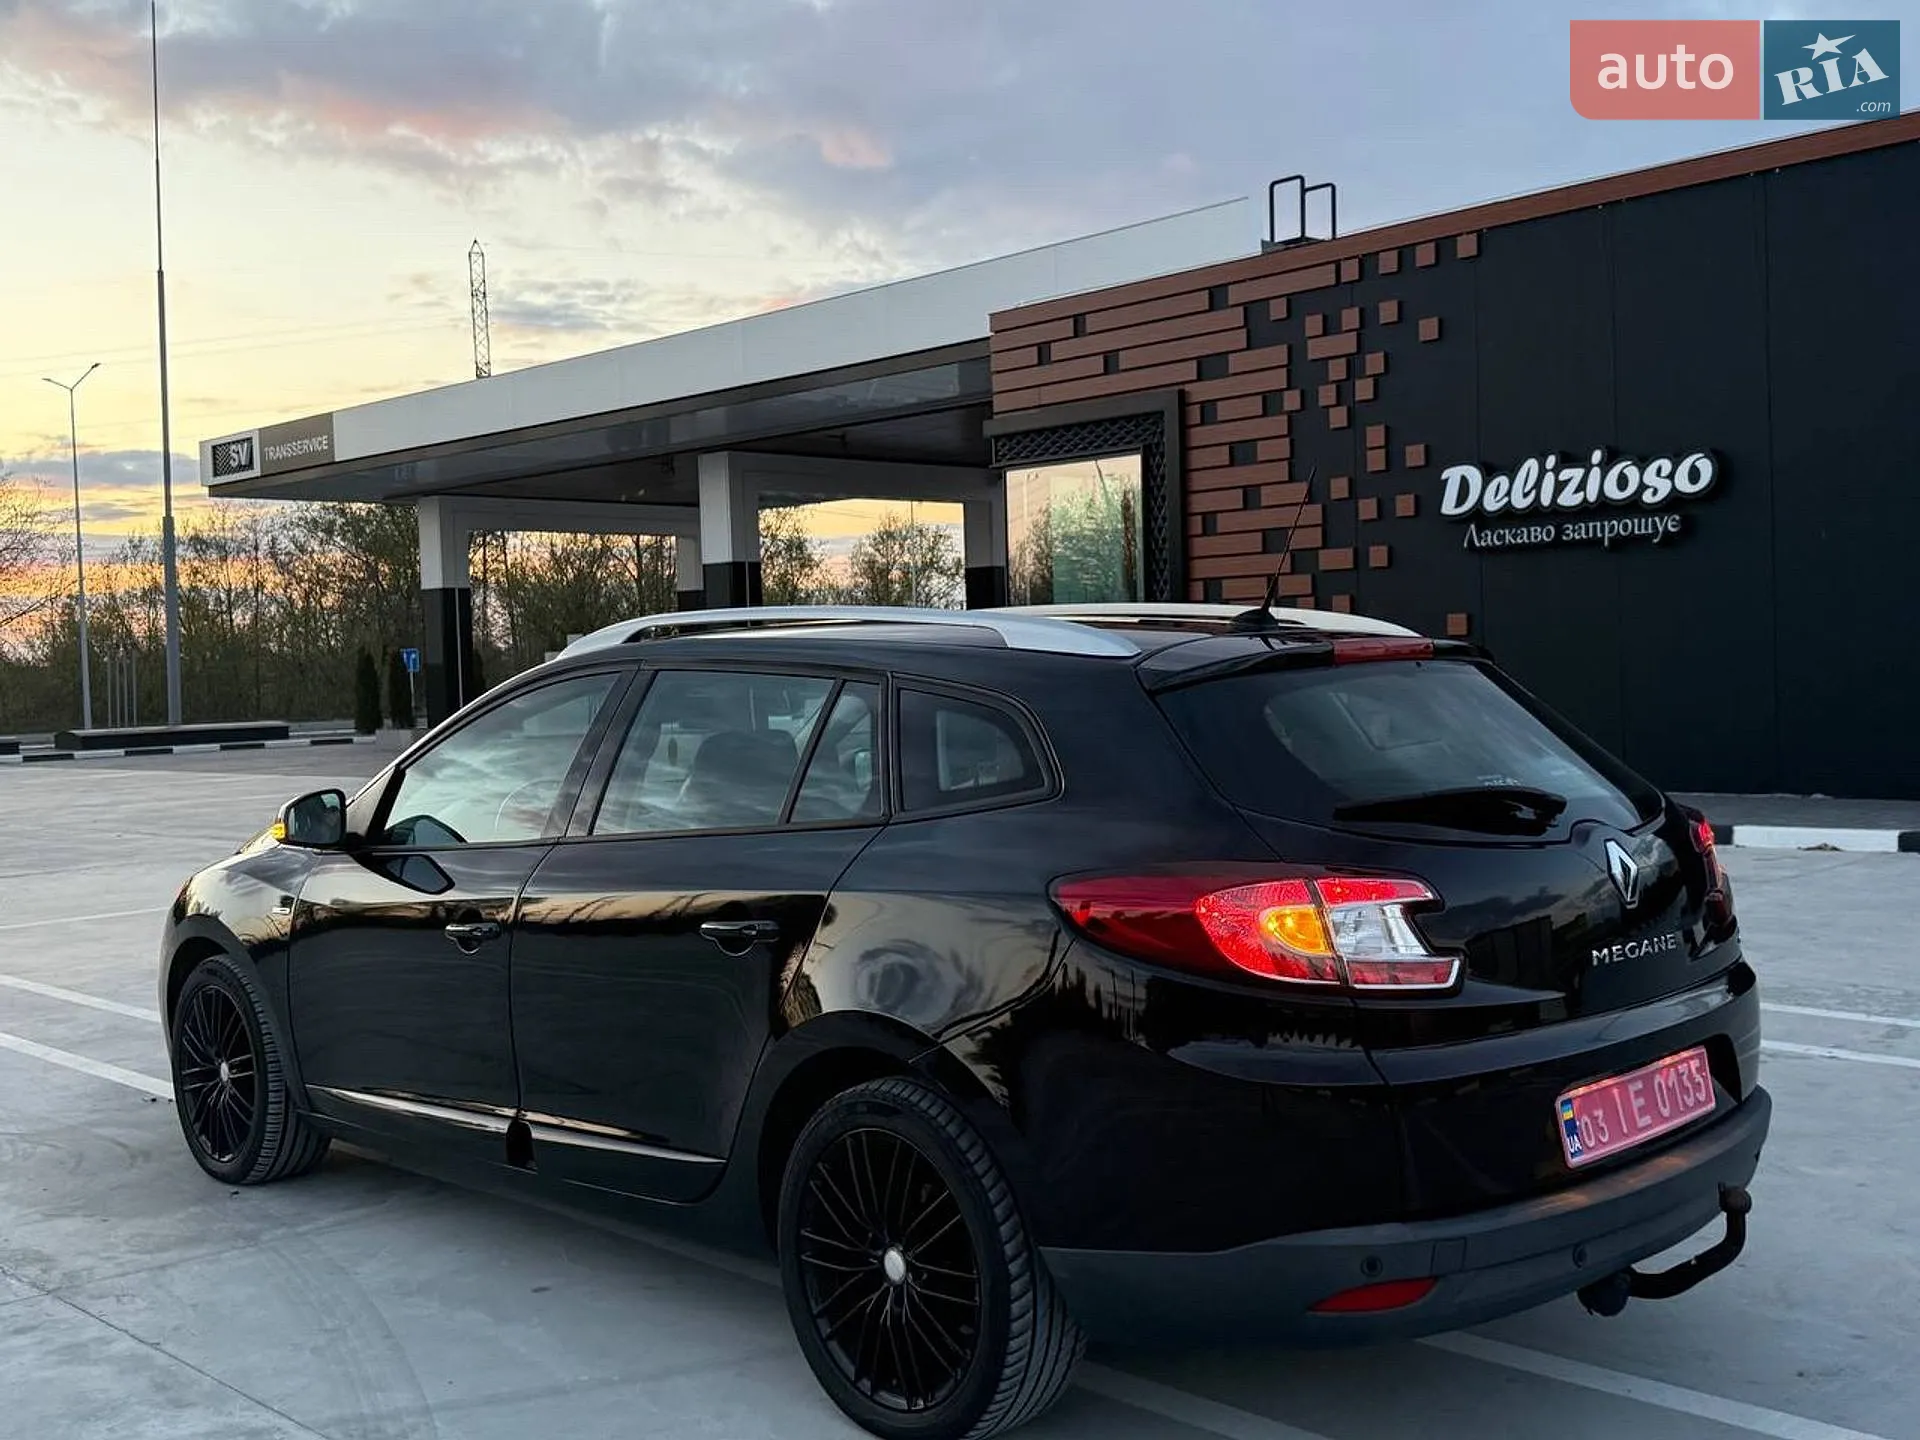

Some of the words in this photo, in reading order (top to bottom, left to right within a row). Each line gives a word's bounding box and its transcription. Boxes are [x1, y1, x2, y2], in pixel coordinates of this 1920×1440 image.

[264, 435, 329, 461] TRANSSERVICE
[1440, 449, 1713, 515] Delizioso
[1464, 524, 1555, 548] Ласкаво
[1562, 514, 1682, 547] запрошує
[1591, 934, 1677, 966] MEGANE
[1580, 1108, 1609, 1148] 03
[1654, 1059, 1706, 1117] 0135
[1566, 1134, 1582, 1153] UA
